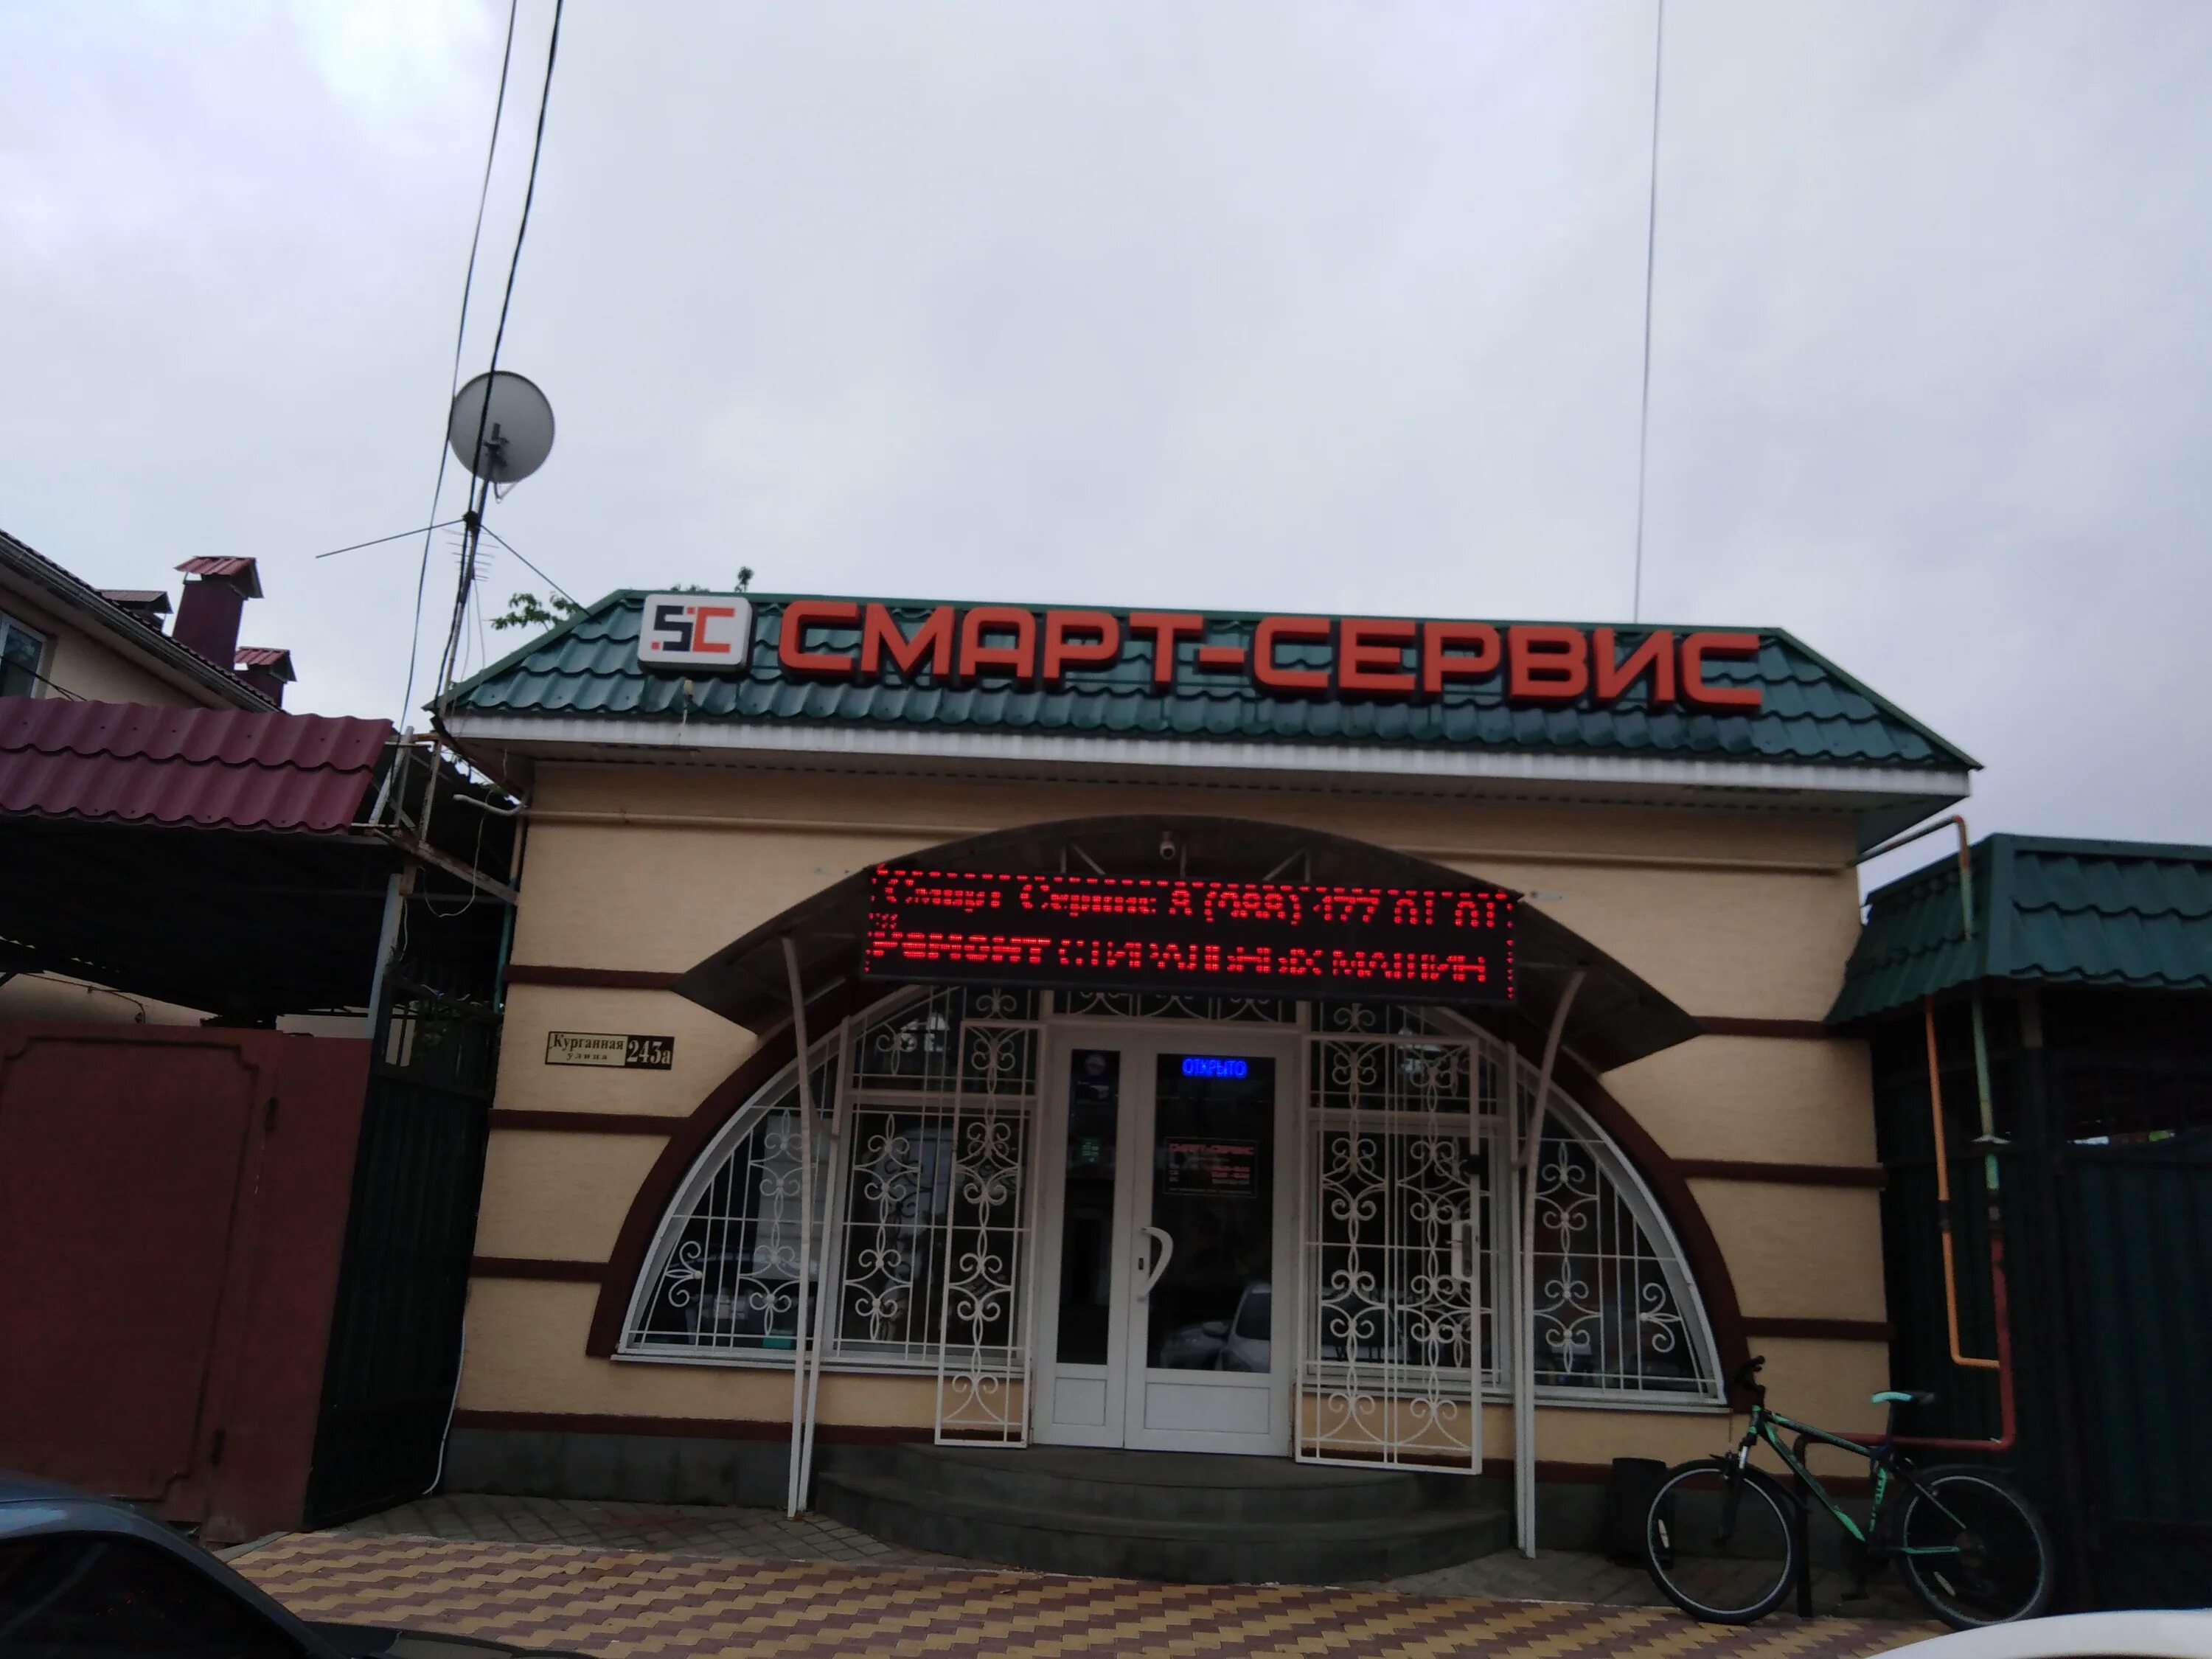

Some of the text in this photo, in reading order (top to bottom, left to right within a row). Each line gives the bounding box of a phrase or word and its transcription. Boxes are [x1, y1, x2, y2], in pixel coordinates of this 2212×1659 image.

[779, 599, 1761, 711] СМАРТ-СЕРВИС
[550, 1033, 625, 1051] Курганная
[1182, 1057, 1248, 1078] ОТКРЫТО
